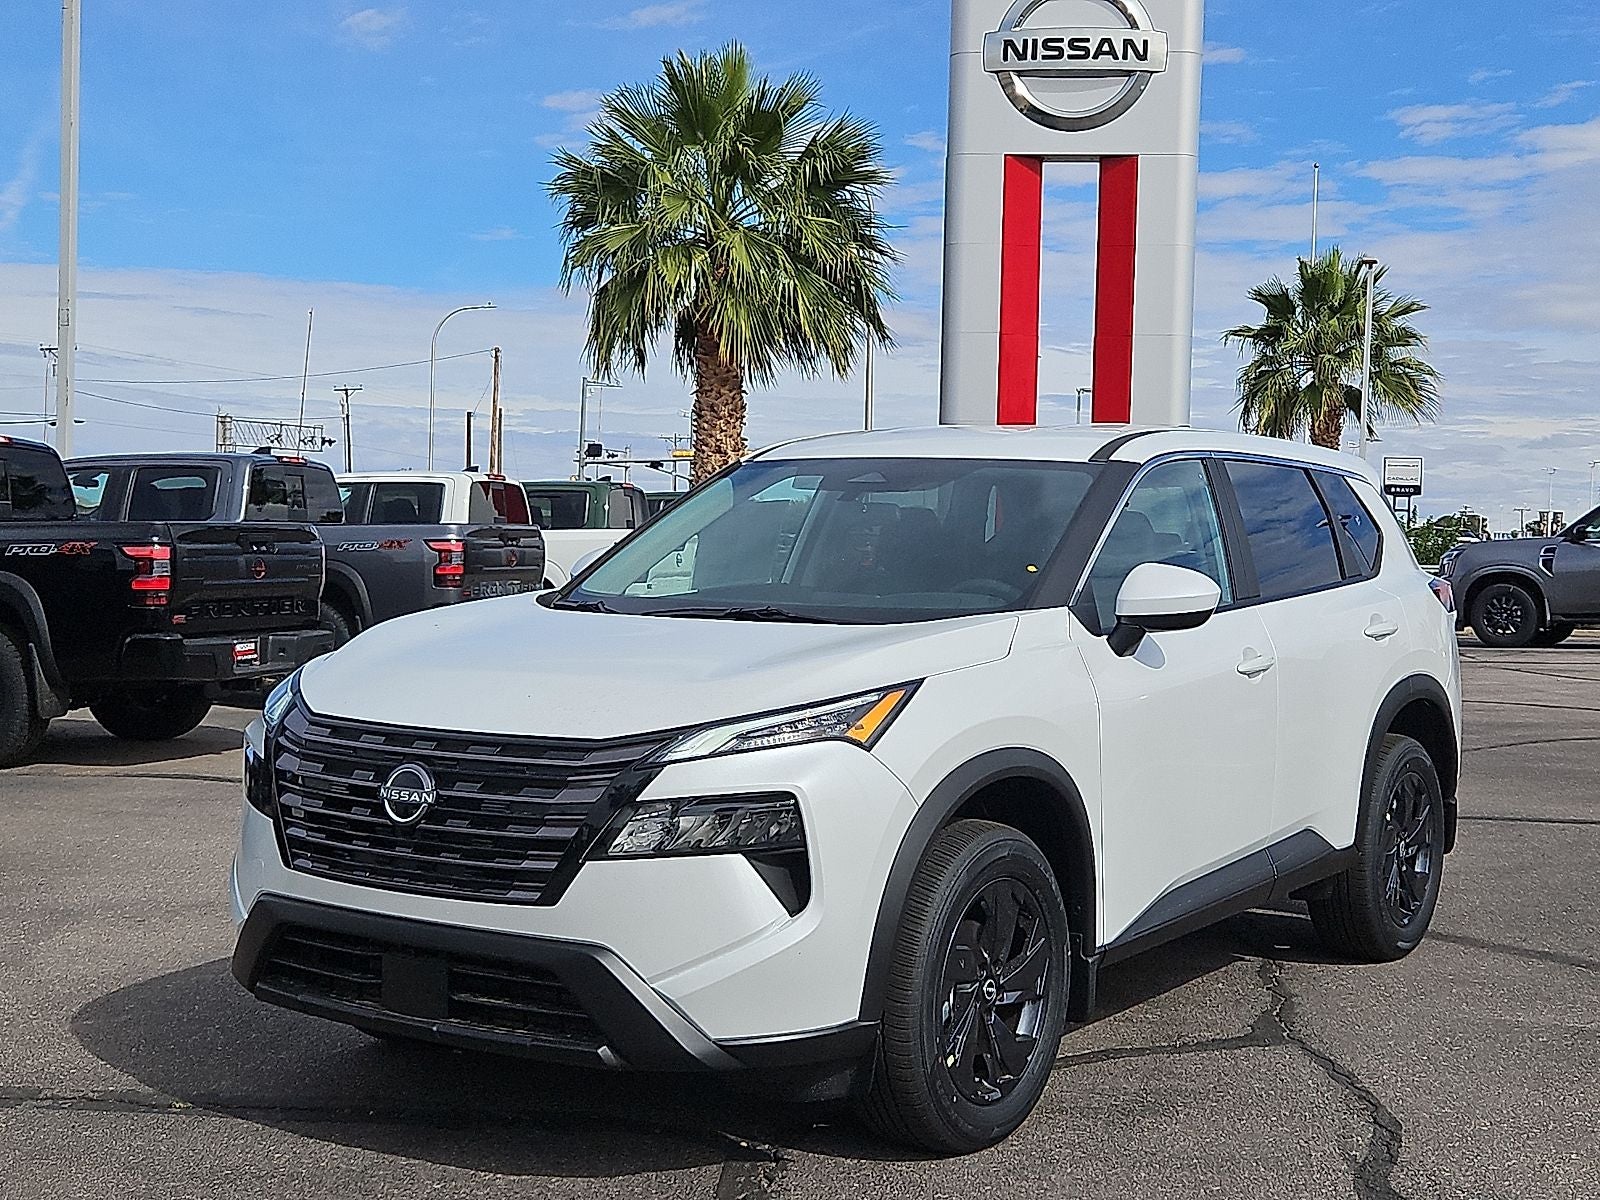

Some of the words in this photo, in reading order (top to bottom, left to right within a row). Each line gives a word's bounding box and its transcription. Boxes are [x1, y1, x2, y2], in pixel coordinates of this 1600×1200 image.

[1001, 37, 1149, 62] NISSAN
[186, 600, 306, 620] FRONTIER
[380, 786, 433, 803] NISSAN
